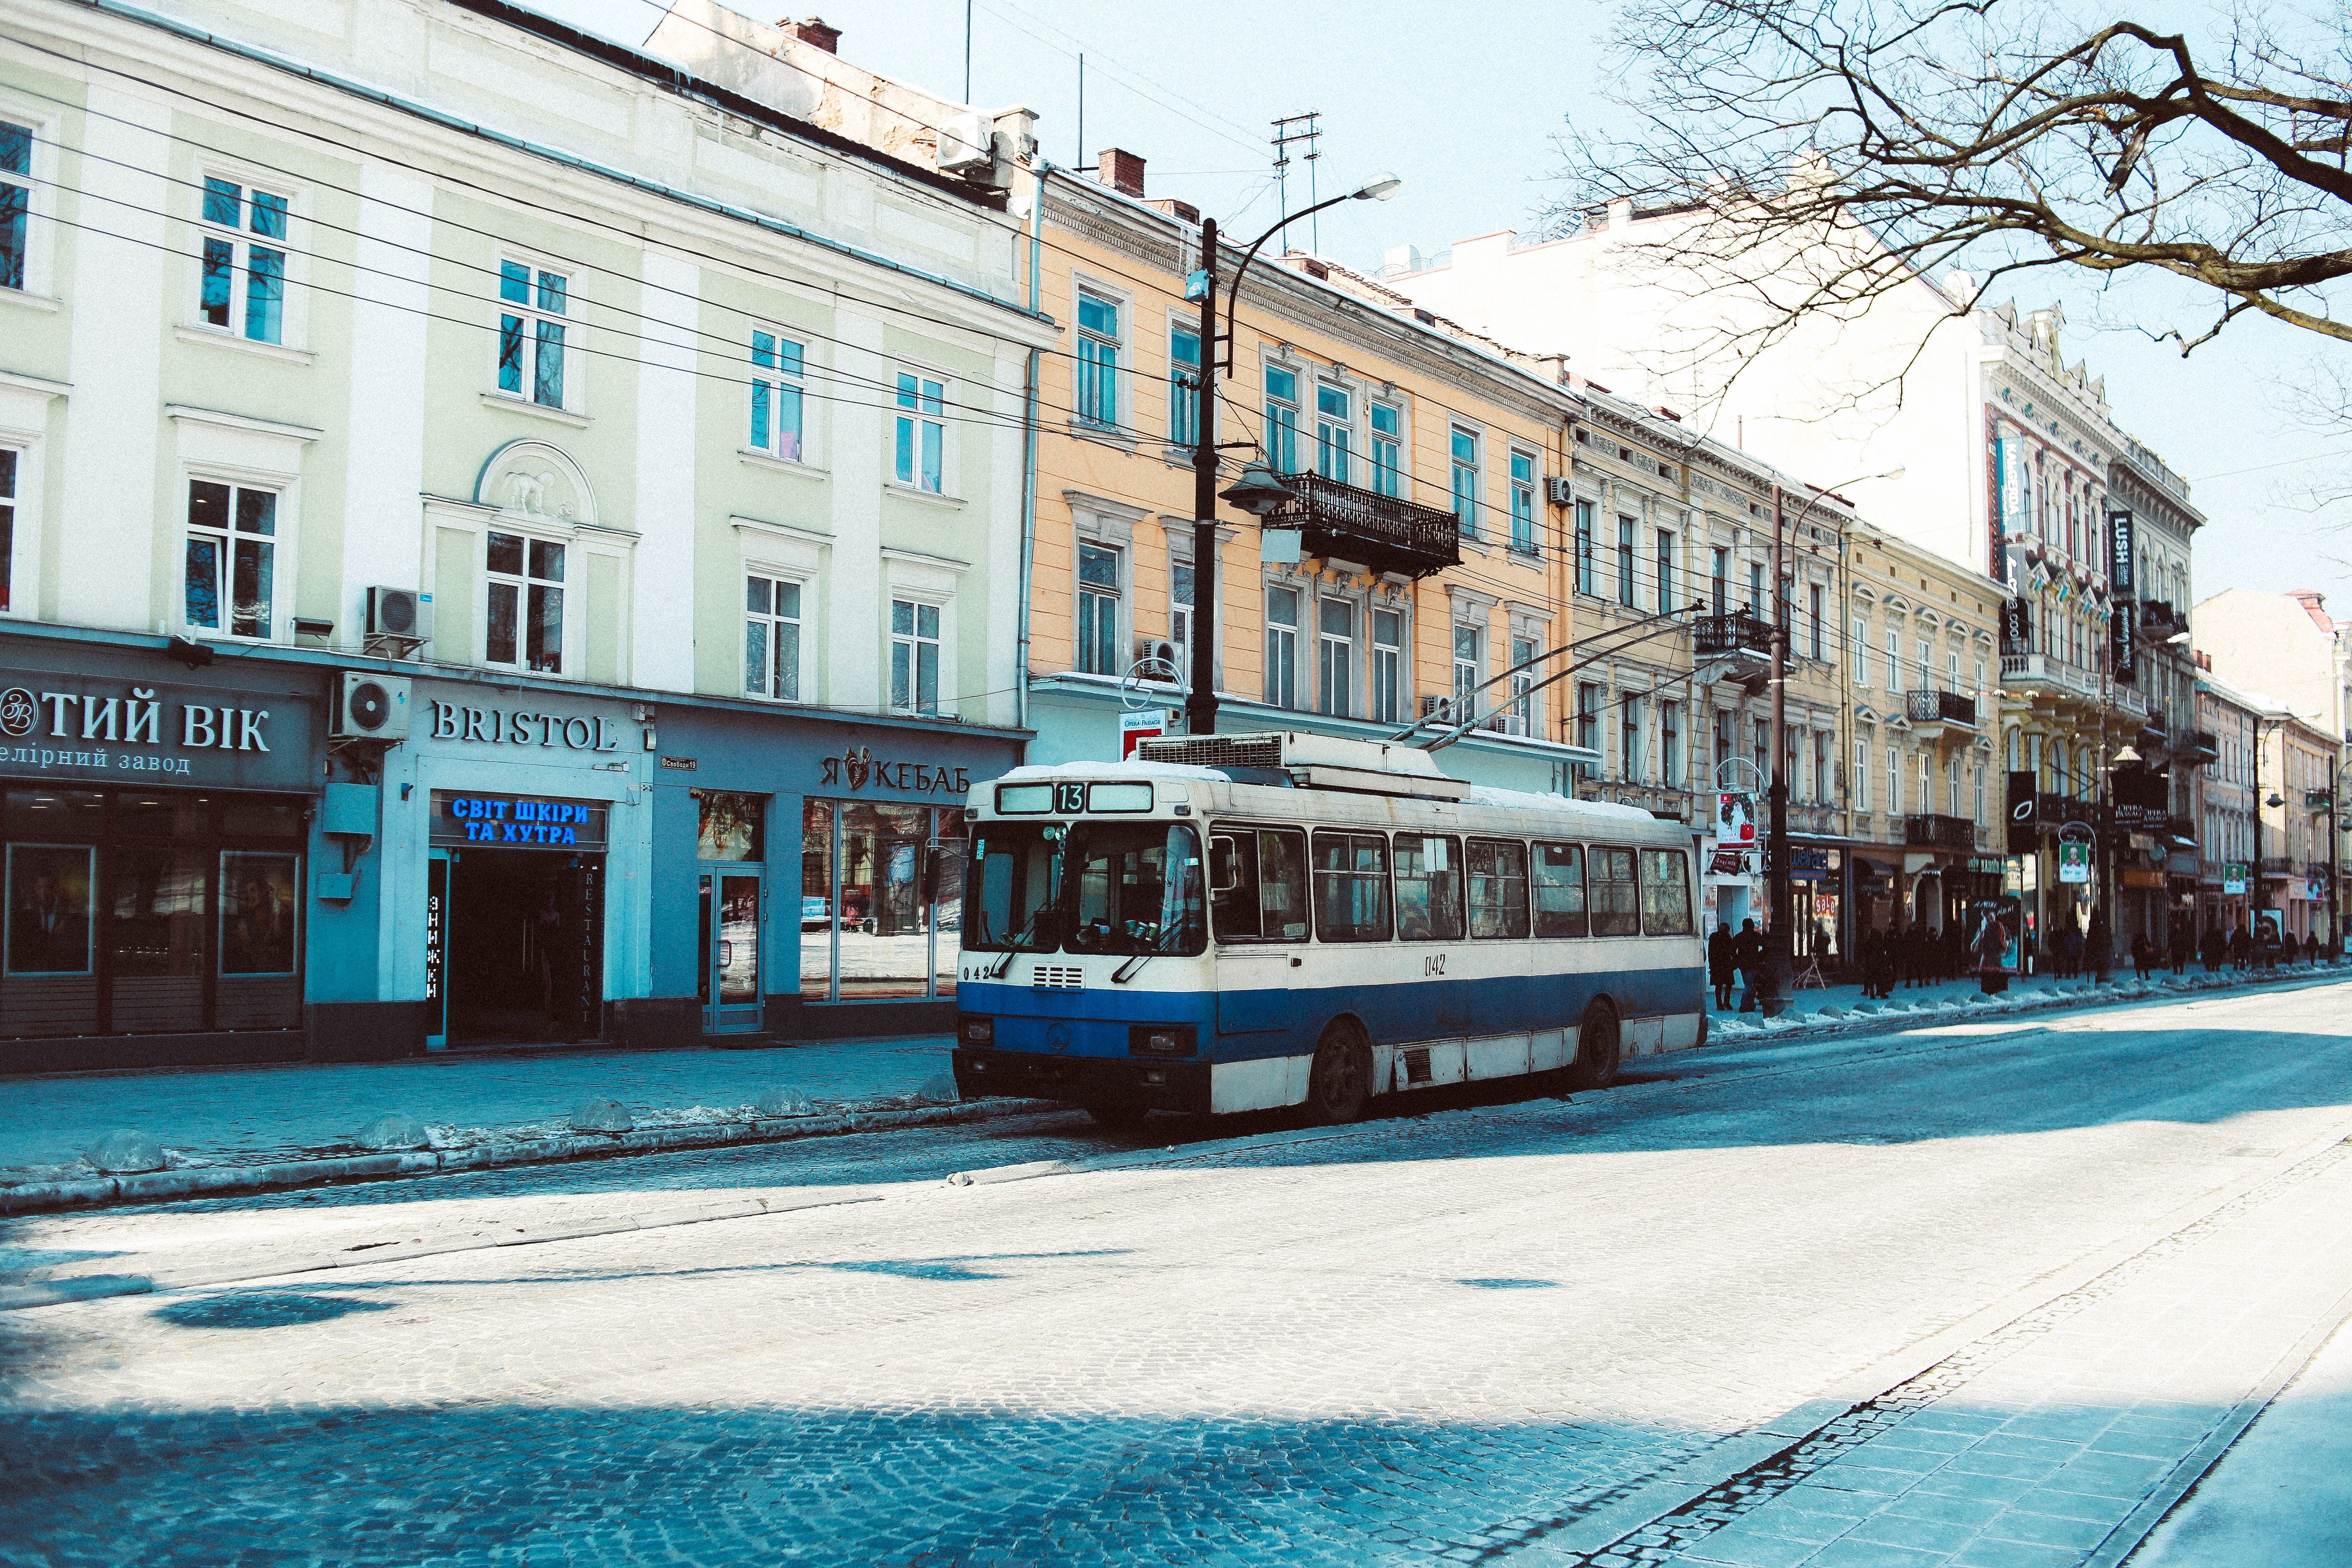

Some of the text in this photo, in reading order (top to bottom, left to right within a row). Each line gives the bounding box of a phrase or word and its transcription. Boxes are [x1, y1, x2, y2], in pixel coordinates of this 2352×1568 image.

[2115, 517, 2128, 564] LUSH
[183, 704, 270, 752] ВІК
[431, 700, 618, 751] BRISTOL
[119, 755, 190, 775] завод
[820, 756, 970, 796] Я КЕБАБ
[1060, 785, 1083, 810] 13
[453, 798, 589, 824] СВІТ ШКІРИ
[465, 821, 576, 845] ТА ХУТРА
[426, 896, 441, 998] ЗНИЖКИ
[963, 966, 990, 981] 042
[1425, 953, 1446, 977] 042
